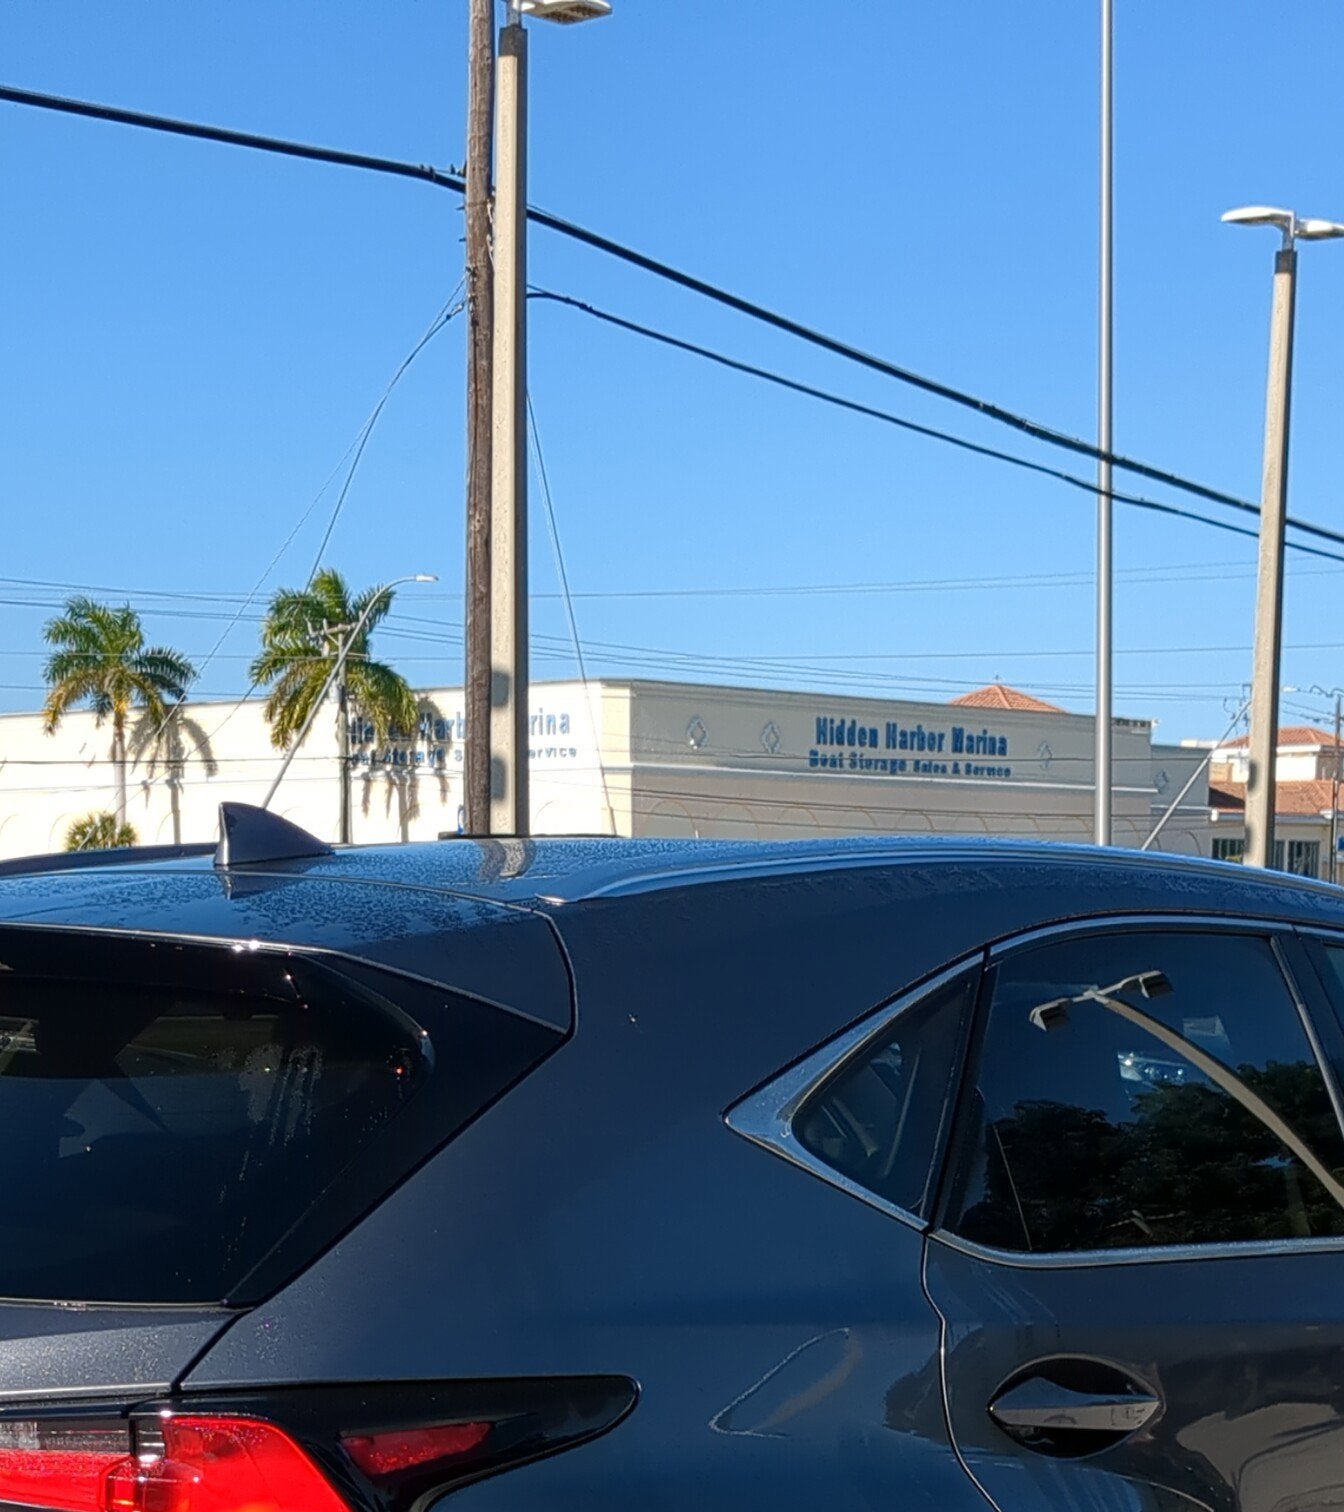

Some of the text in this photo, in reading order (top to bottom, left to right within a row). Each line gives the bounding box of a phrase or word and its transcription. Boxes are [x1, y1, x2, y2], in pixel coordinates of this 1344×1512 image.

[816, 716, 1008, 757] Hidden Harbor Marina
[529, 747, 577, 759] ervice
